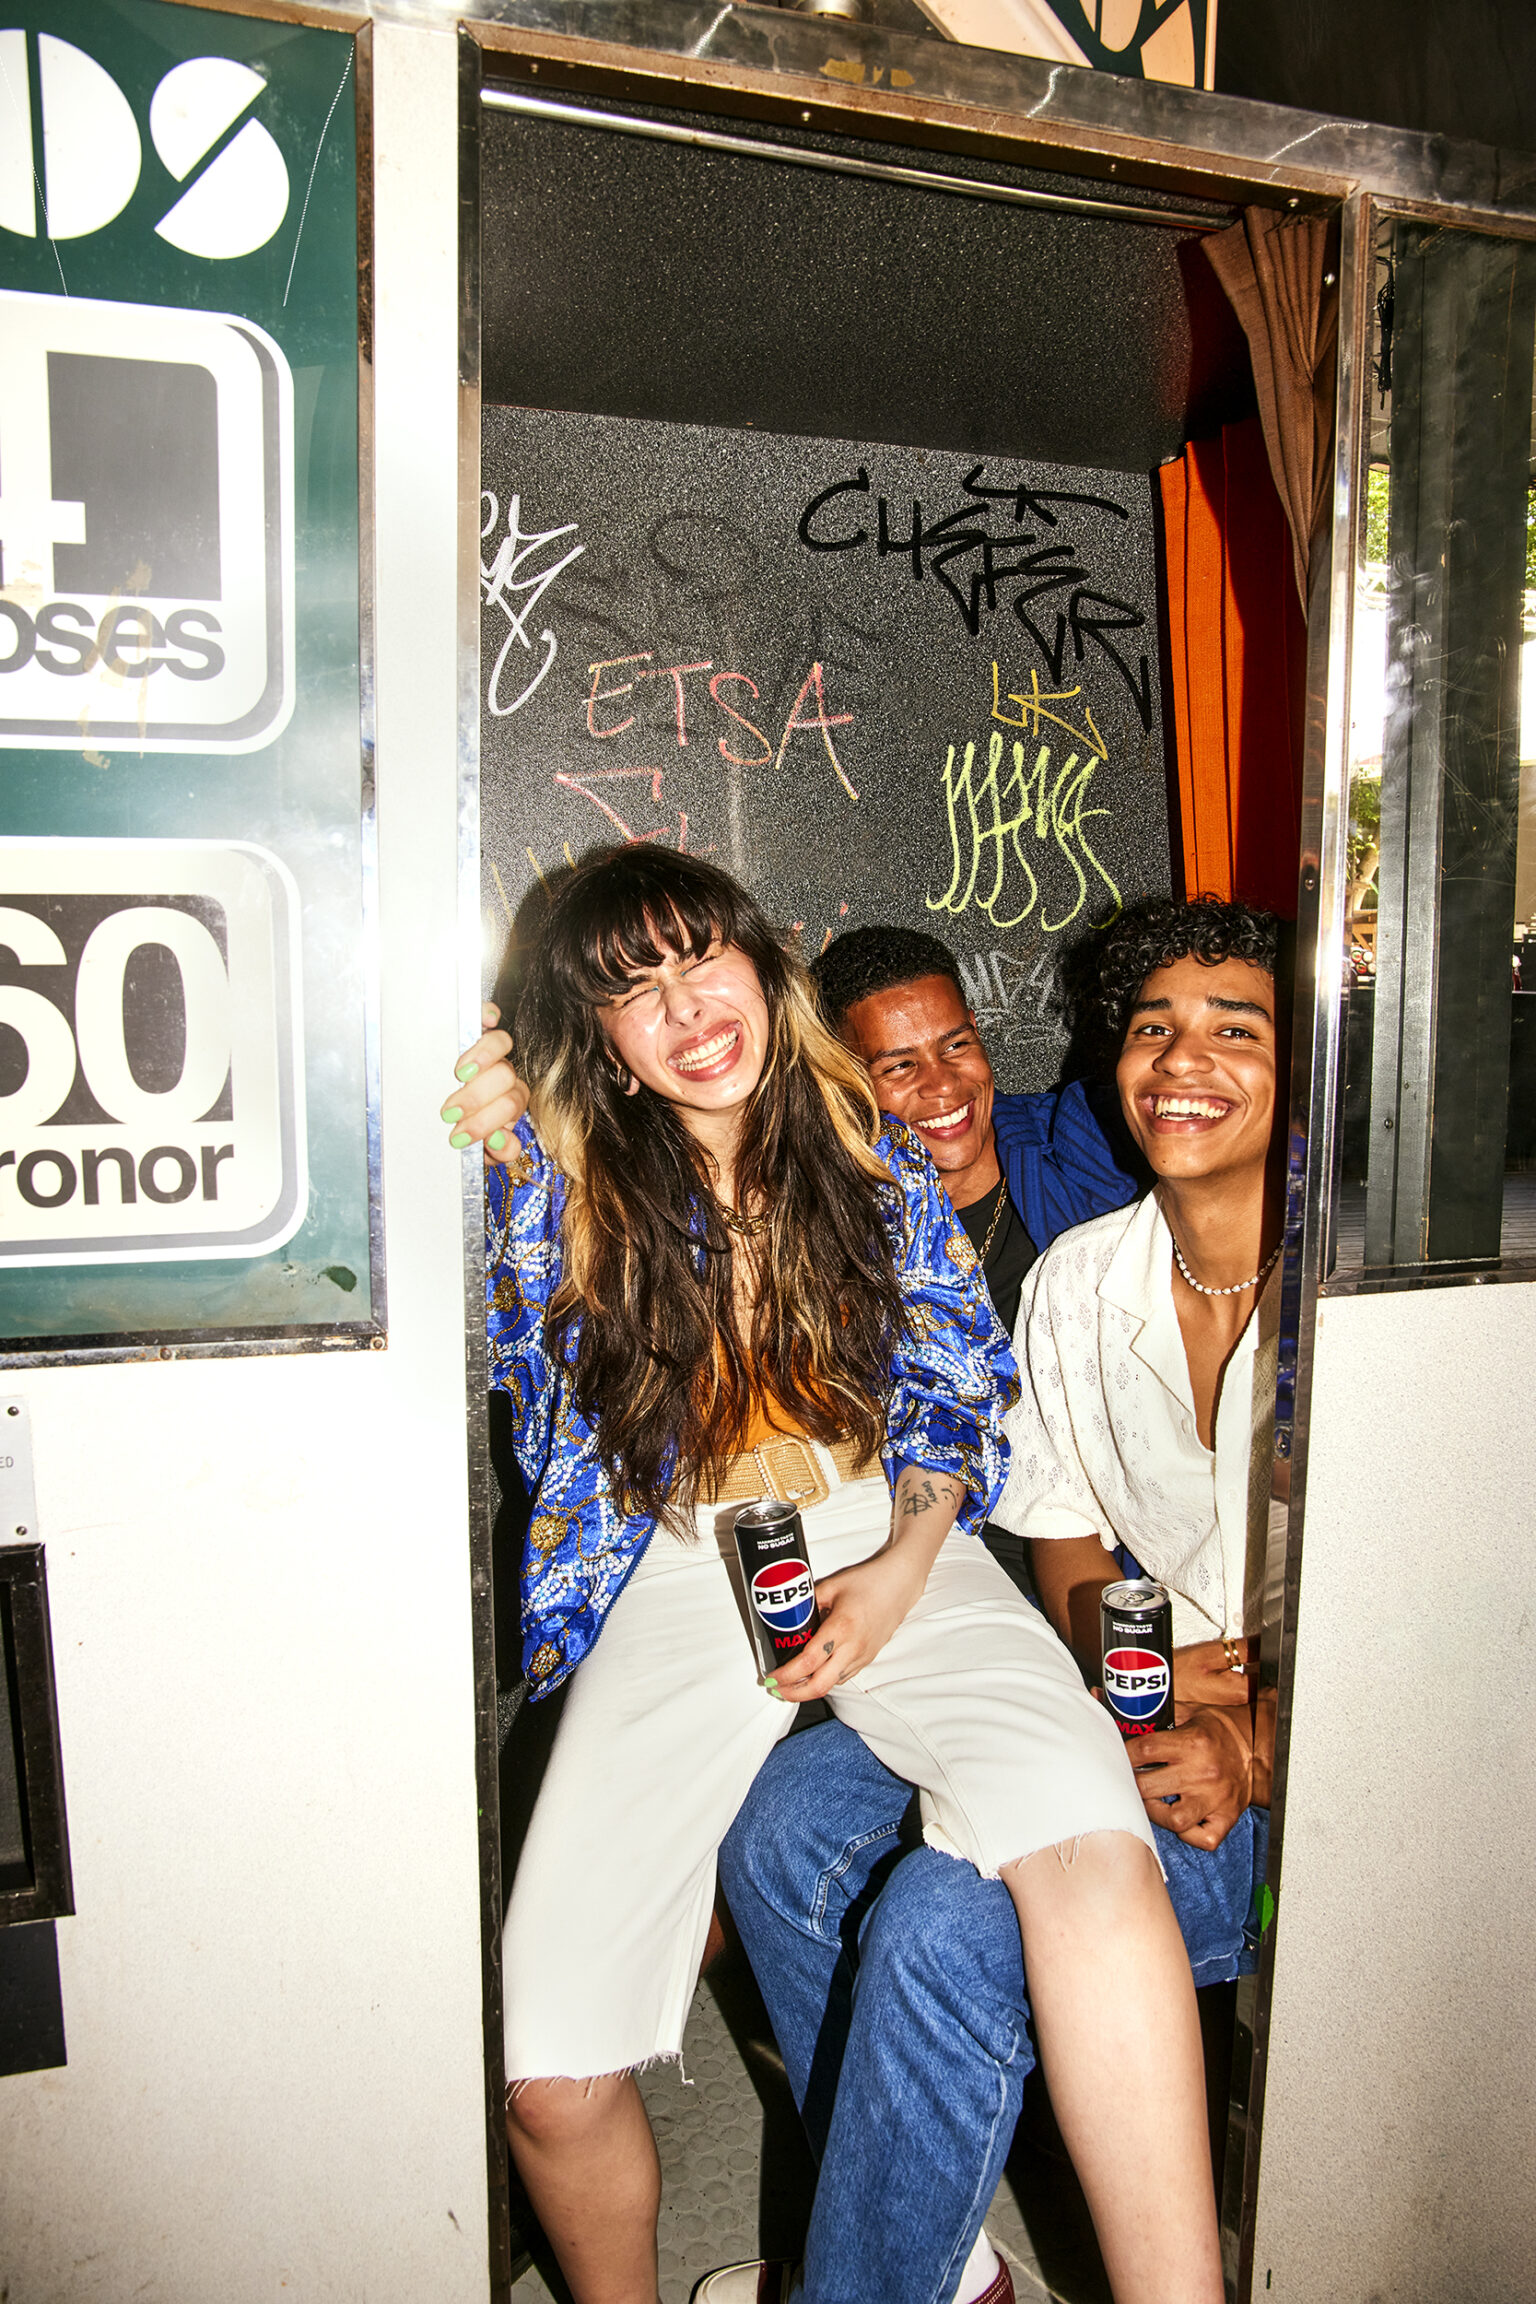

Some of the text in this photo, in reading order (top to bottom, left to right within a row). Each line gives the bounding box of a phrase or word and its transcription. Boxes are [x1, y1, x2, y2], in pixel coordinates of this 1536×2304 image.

[755, 1577, 812, 1605] PEPSI
[774, 1628, 813, 1648] MAX
[1105, 1668, 1166, 1690] PEPSI
